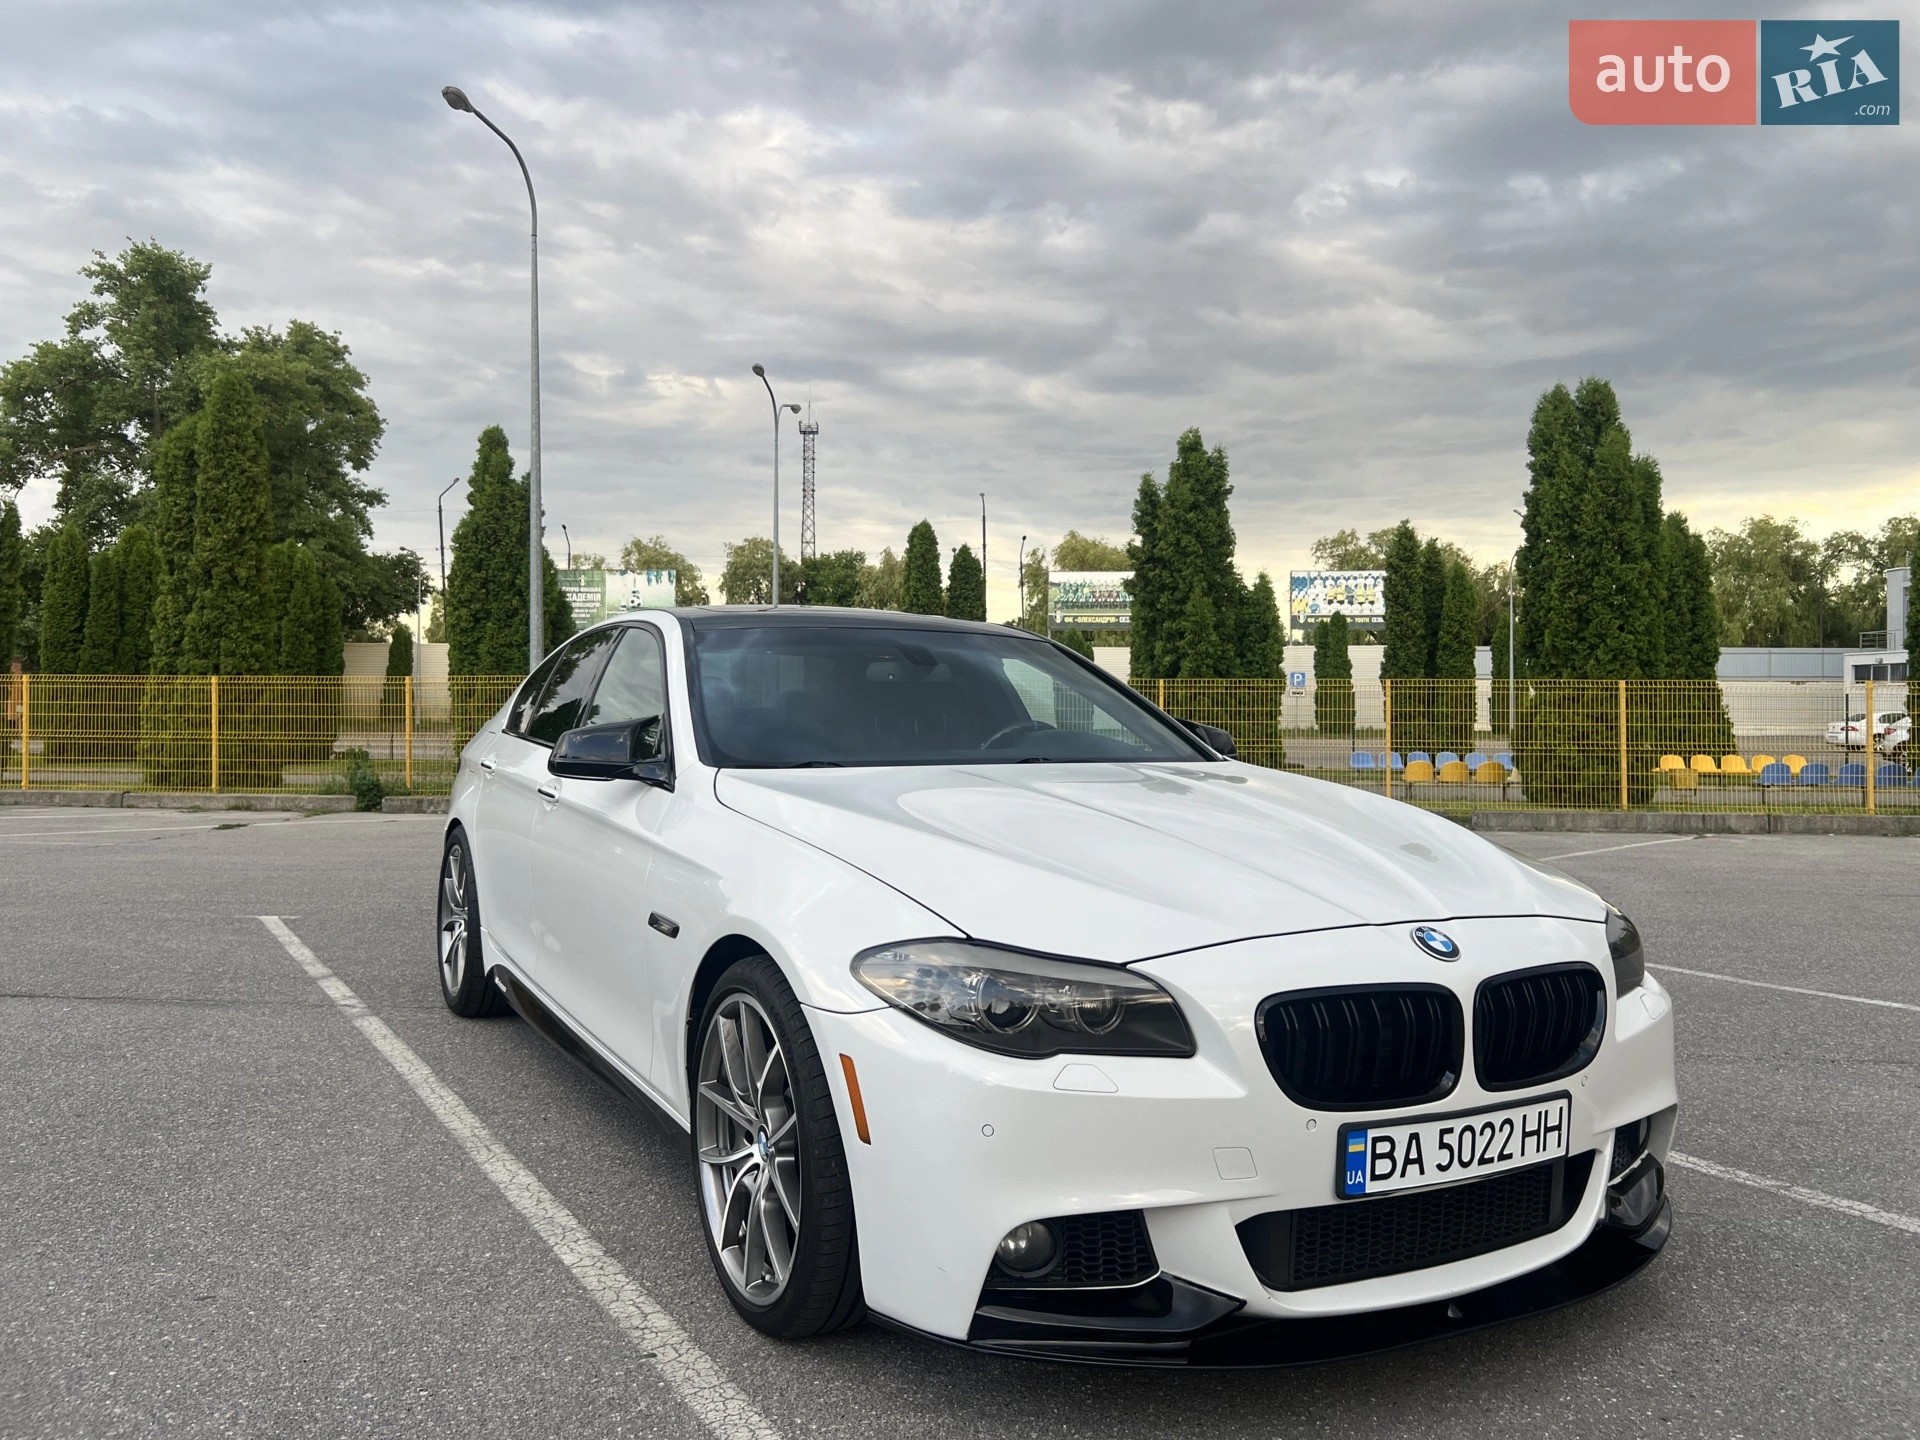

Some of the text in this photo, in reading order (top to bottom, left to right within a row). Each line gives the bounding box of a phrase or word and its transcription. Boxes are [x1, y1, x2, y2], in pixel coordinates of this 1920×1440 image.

[565, 593, 602, 602] КАДЕМІЯ
[1294, 673, 1303, 686] P
[1369, 1106, 1564, 1182] BA 5022 HH
[1346, 1169, 1364, 1185] UA
